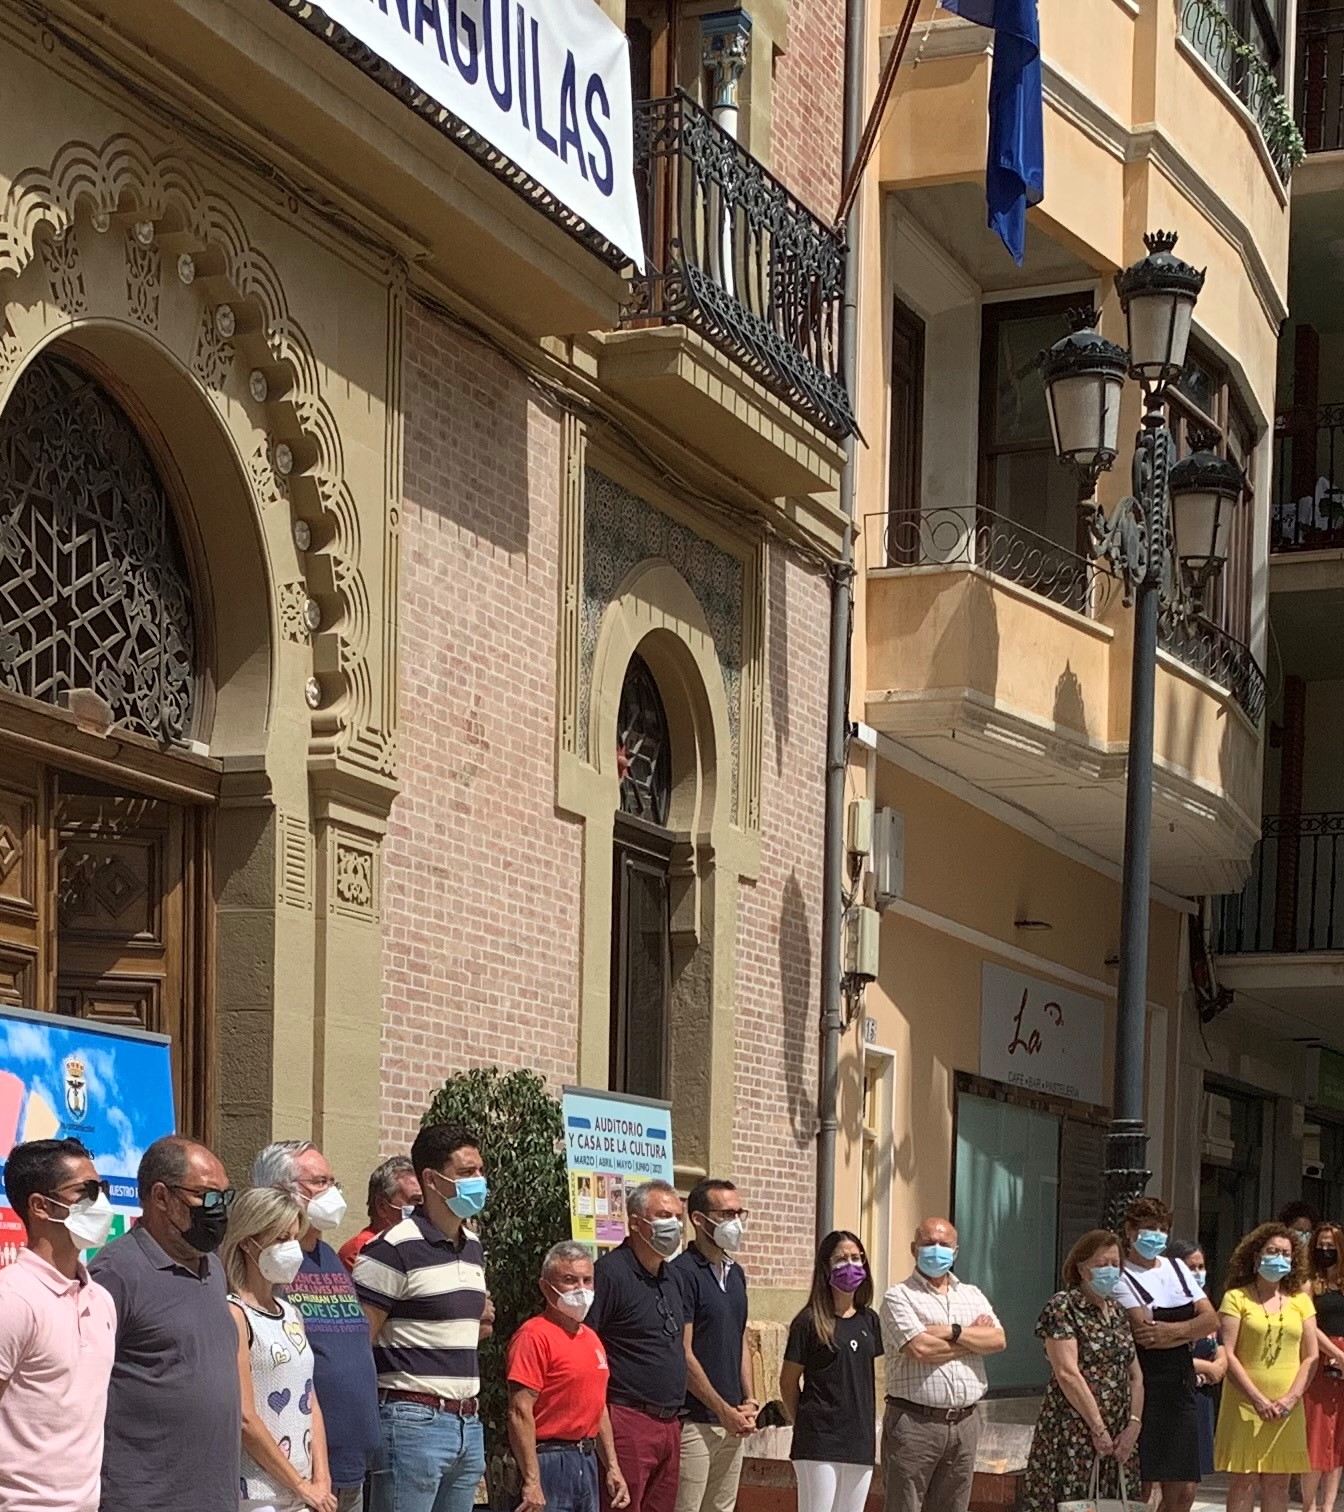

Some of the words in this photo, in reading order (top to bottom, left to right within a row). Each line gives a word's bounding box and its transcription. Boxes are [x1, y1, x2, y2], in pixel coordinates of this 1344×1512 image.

[595, 1116, 643, 1138] AUDITORIO
[568, 1132, 575, 1148] Y
[578, 1133, 602, 1151] CASA
[604, 1136, 615, 1153] DE
[617, 1139, 627, 1154] LA
[630, 1140, 667, 1160] CULTURA
[574, 1154, 595, 1167] MARZO
[598, 1157, 613, 1169] ABRIL
[616, 1159, 633, 1172] MAYO
[635, 1161, 650, 1175] JUNIO
[287, 1294, 303, 1304] NO
[330, 1294, 340, 1304] IS
[299, 1303, 328, 1318] OVE
[327, 1303, 341, 1318] IS
